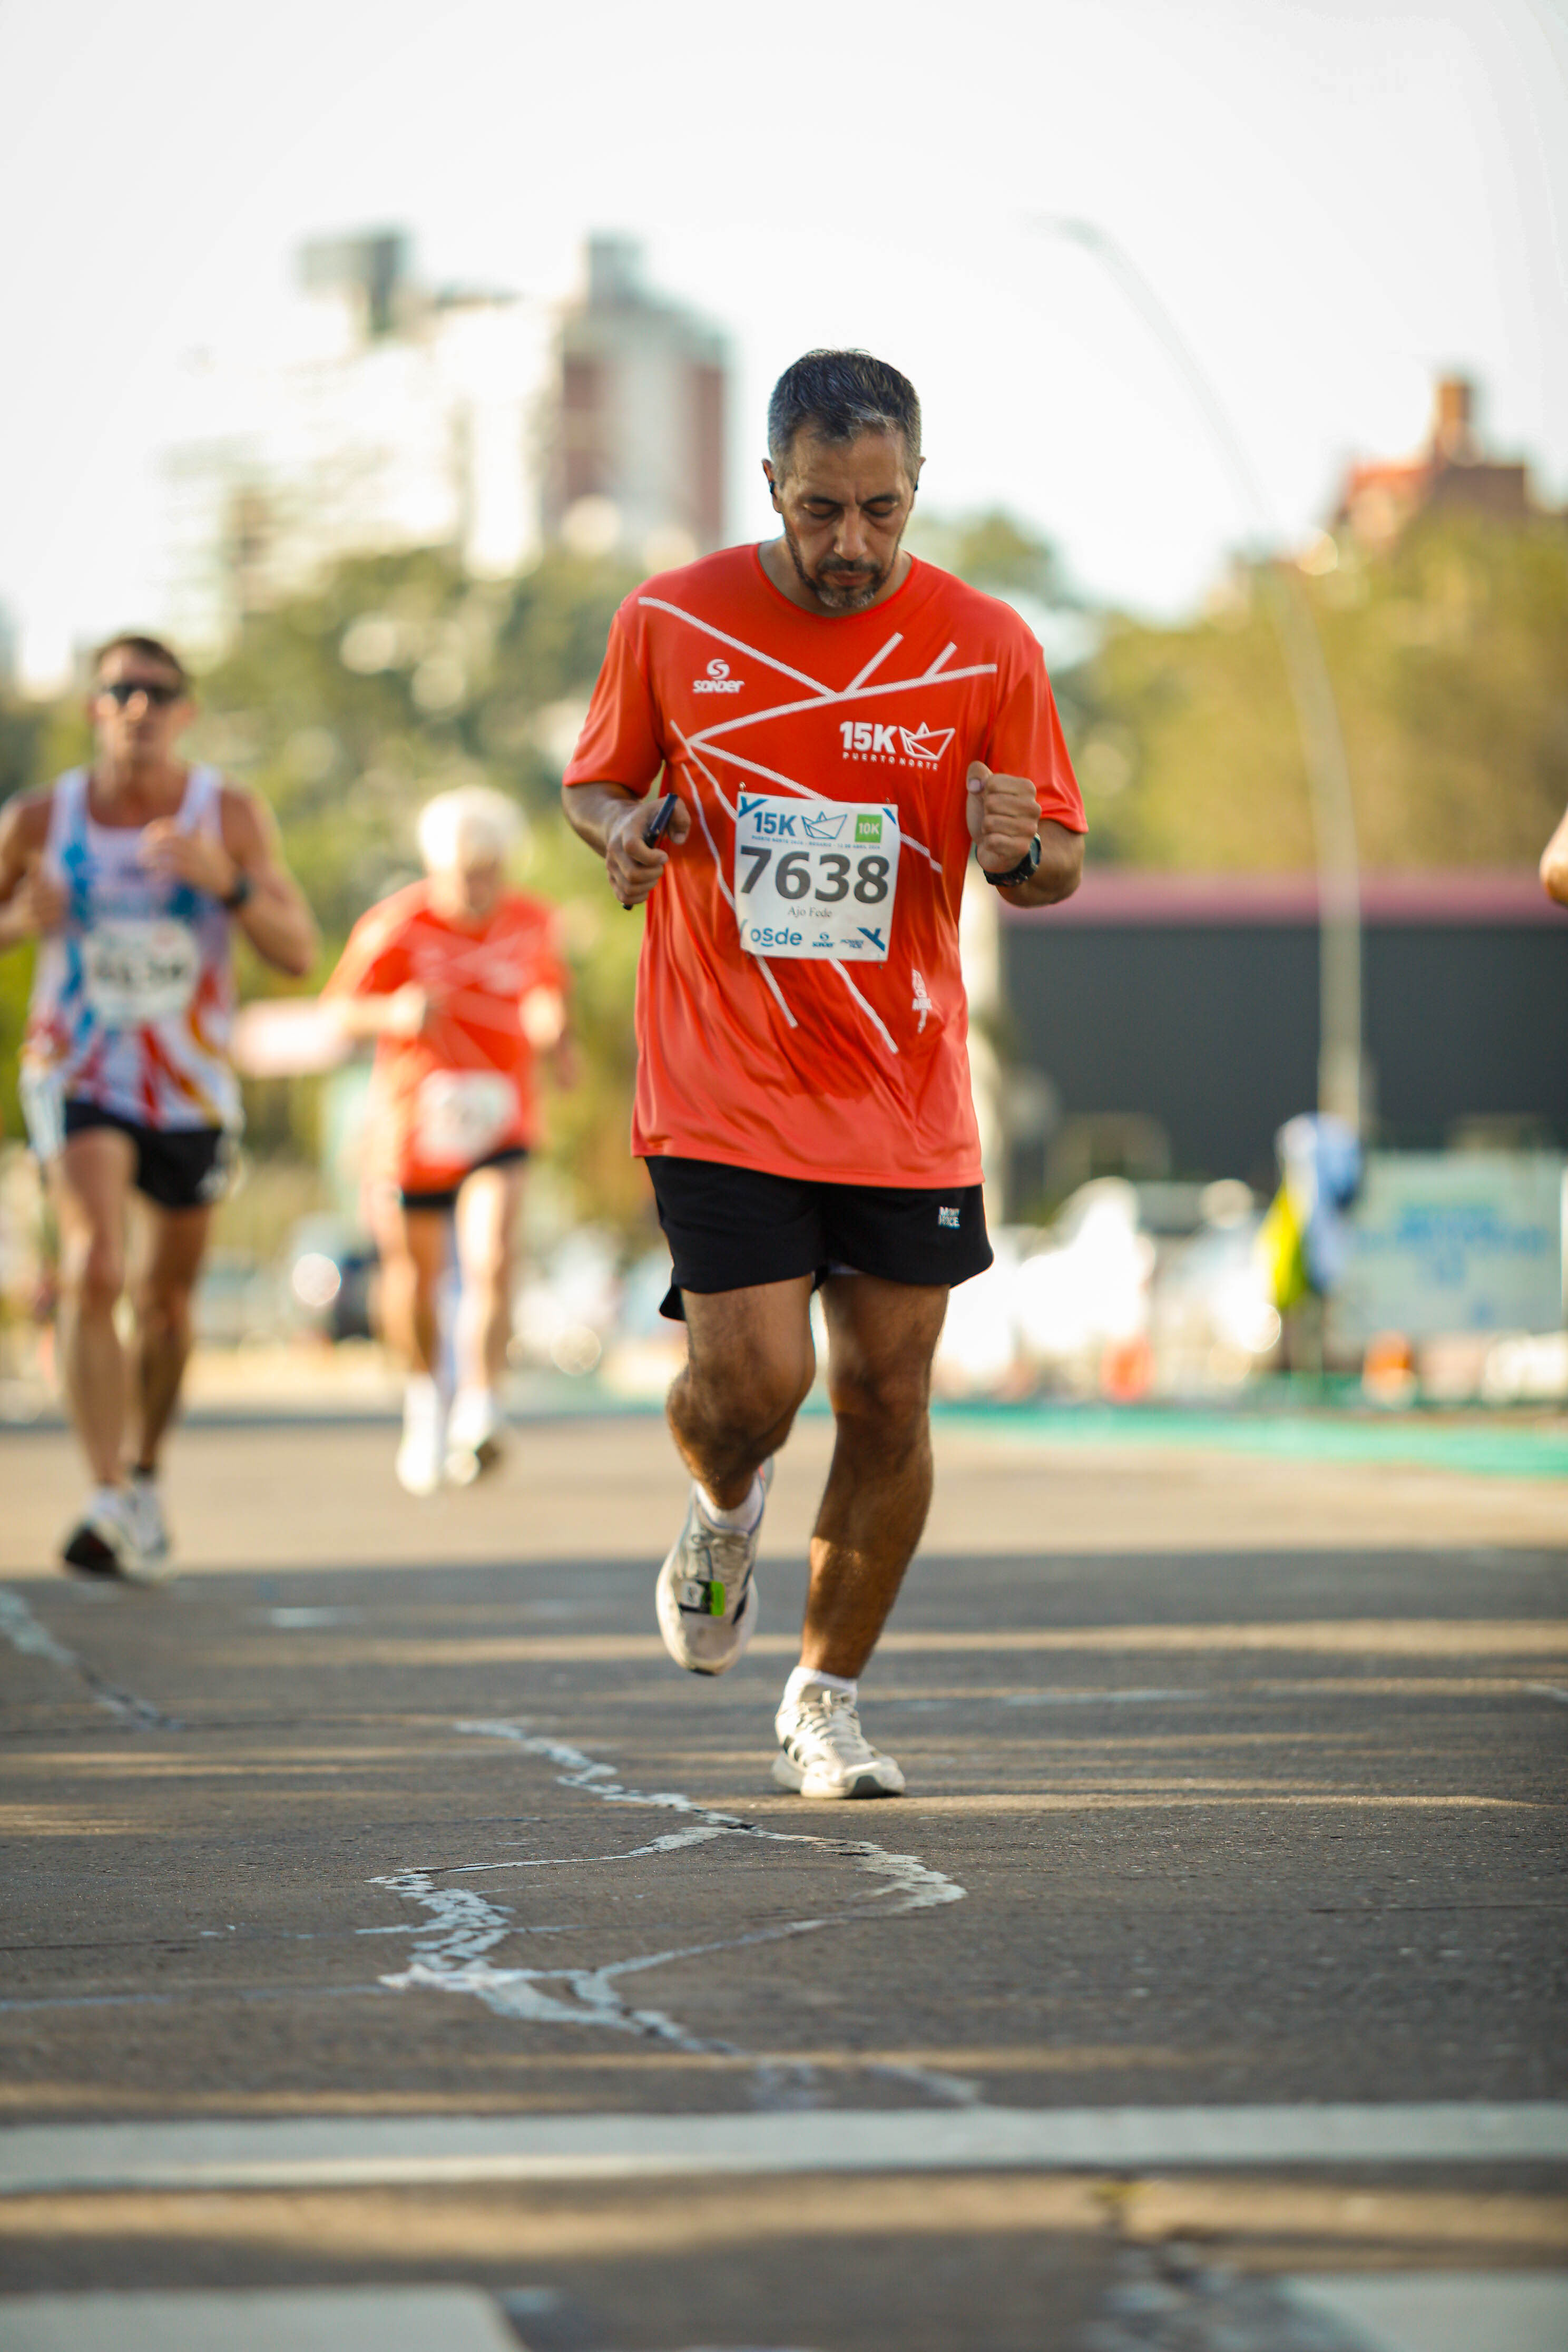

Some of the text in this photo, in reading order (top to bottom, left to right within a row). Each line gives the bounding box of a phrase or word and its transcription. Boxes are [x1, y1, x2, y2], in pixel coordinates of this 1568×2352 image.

[839, 721, 897, 754] 15K
[843, 751, 939, 771] PUERTO NORTE
[754, 811, 797, 837] 15K
[858, 822, 880, 835] 10K
[740, 845, 889, 904] 7638
[750, 927, 802, 946] osde
